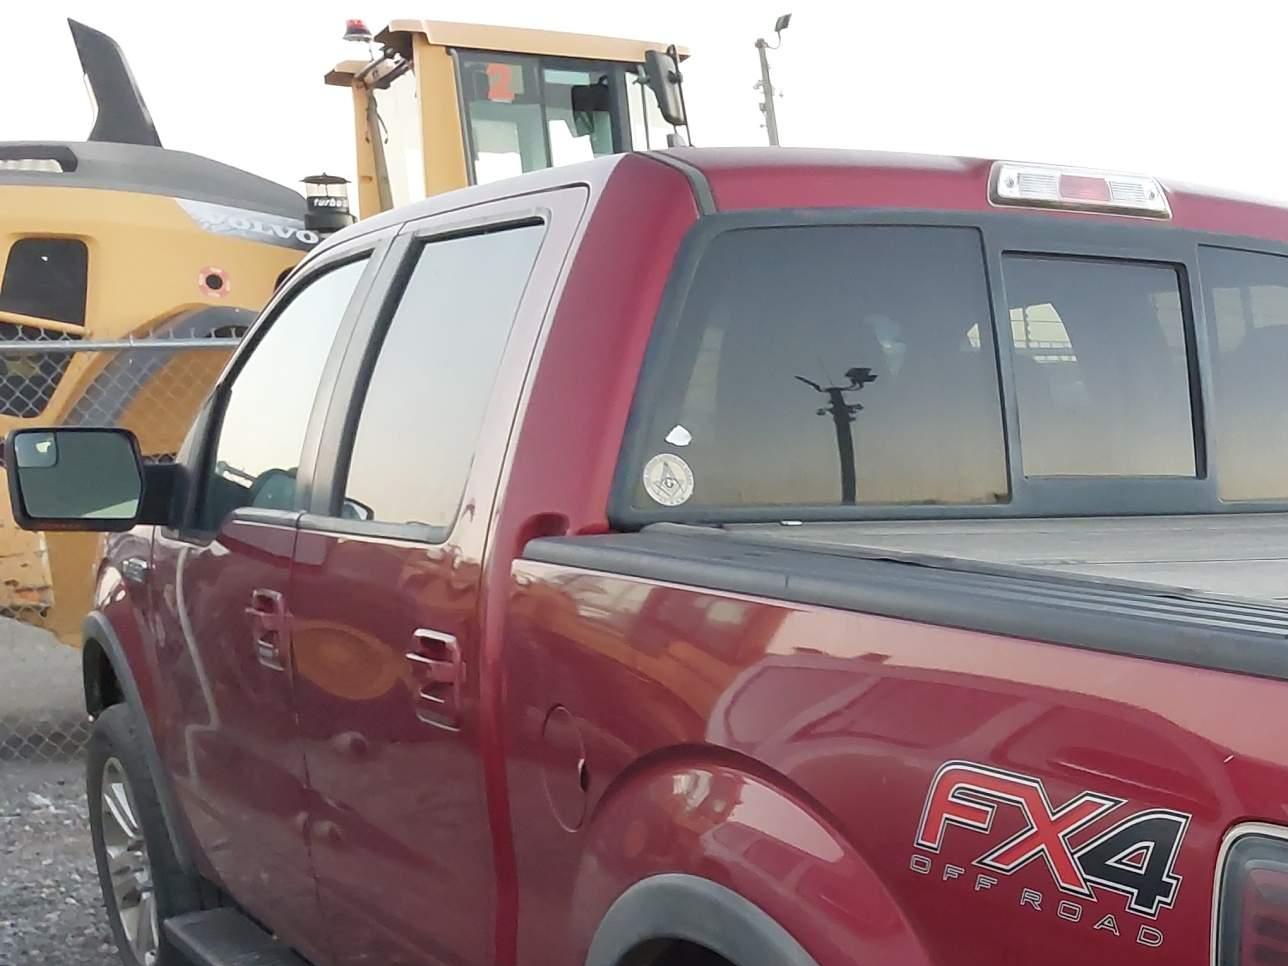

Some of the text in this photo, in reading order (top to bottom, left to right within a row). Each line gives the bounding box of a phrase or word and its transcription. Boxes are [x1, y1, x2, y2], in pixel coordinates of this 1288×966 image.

[485, 63, 515, 102] 2
[207, 215, 320, 244] VOLVO
[914, 760, 1192, 920] FX4
[909, 854, 1164, 947] OFF ROAD
